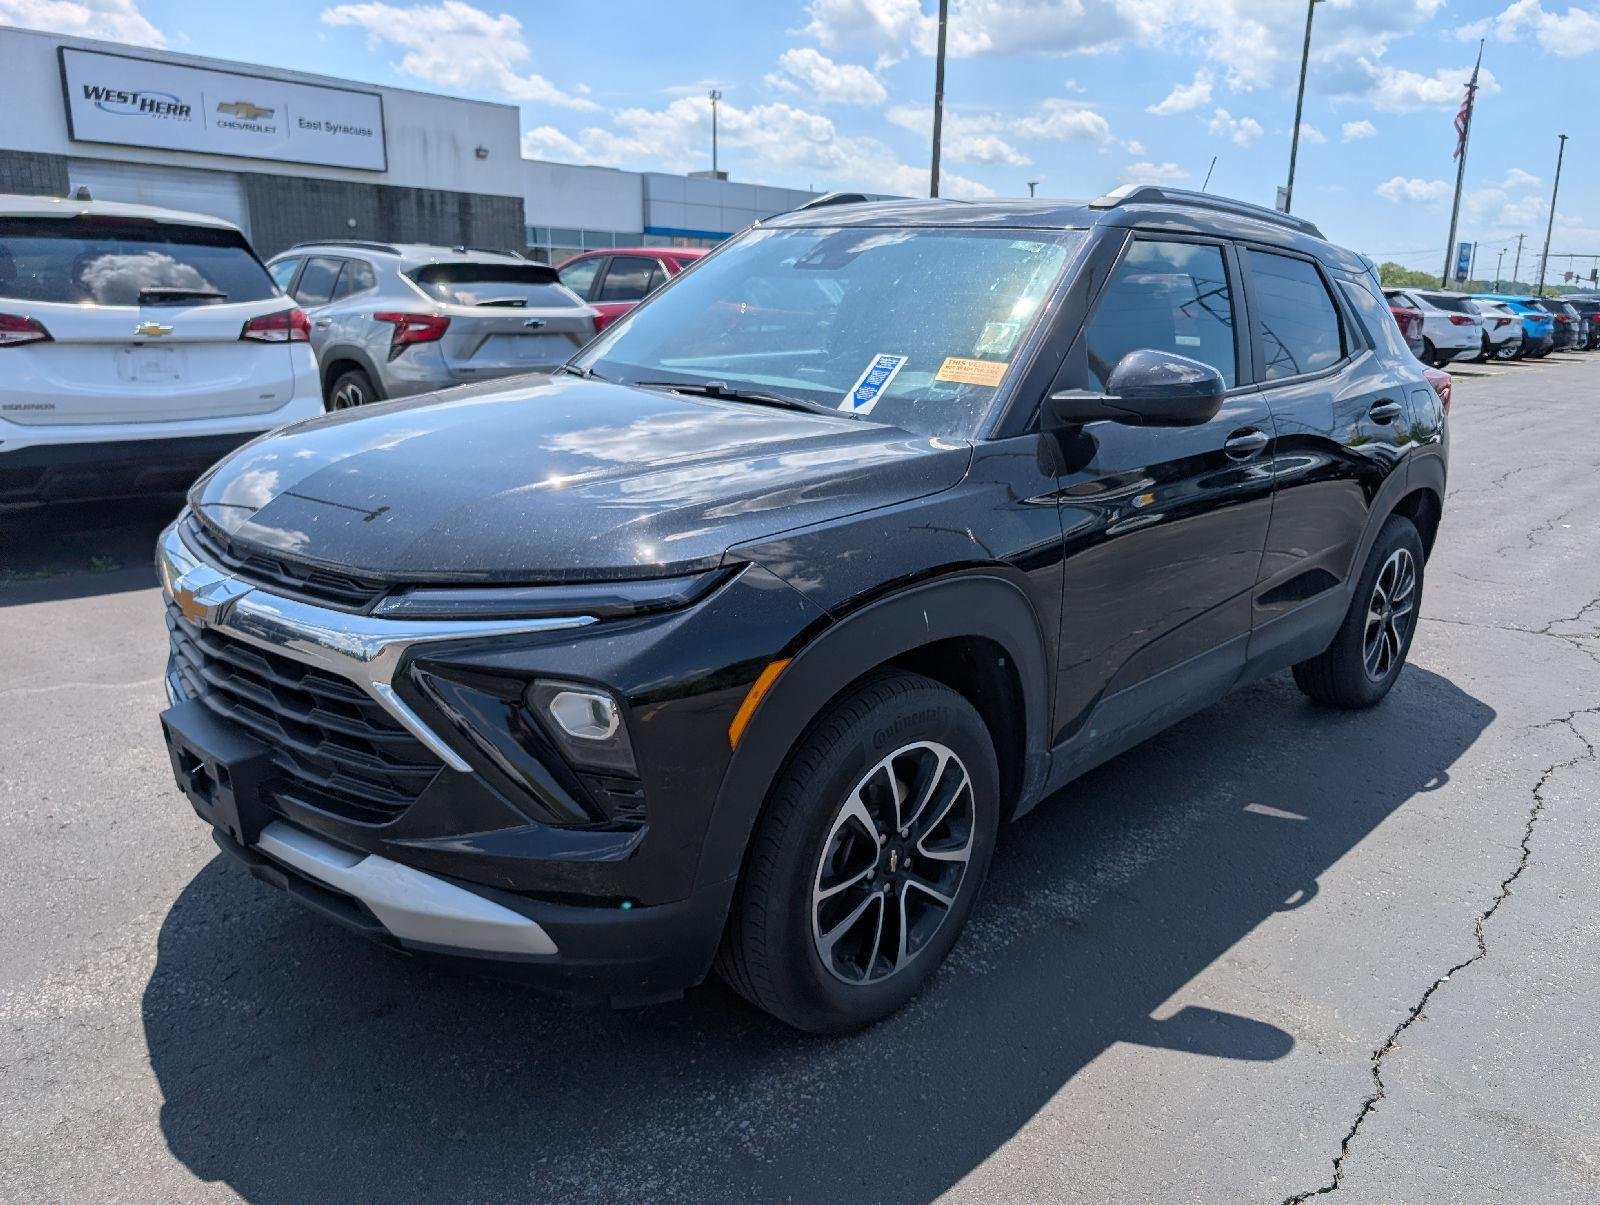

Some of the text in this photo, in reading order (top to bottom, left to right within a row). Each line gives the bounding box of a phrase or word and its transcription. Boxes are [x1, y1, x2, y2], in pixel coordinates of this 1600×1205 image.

[83, 84, 192, 117] WEST HERR
[216, 119, 277, 134] CHEVROLET
[298, 118, 374, 137] East Syracuse
